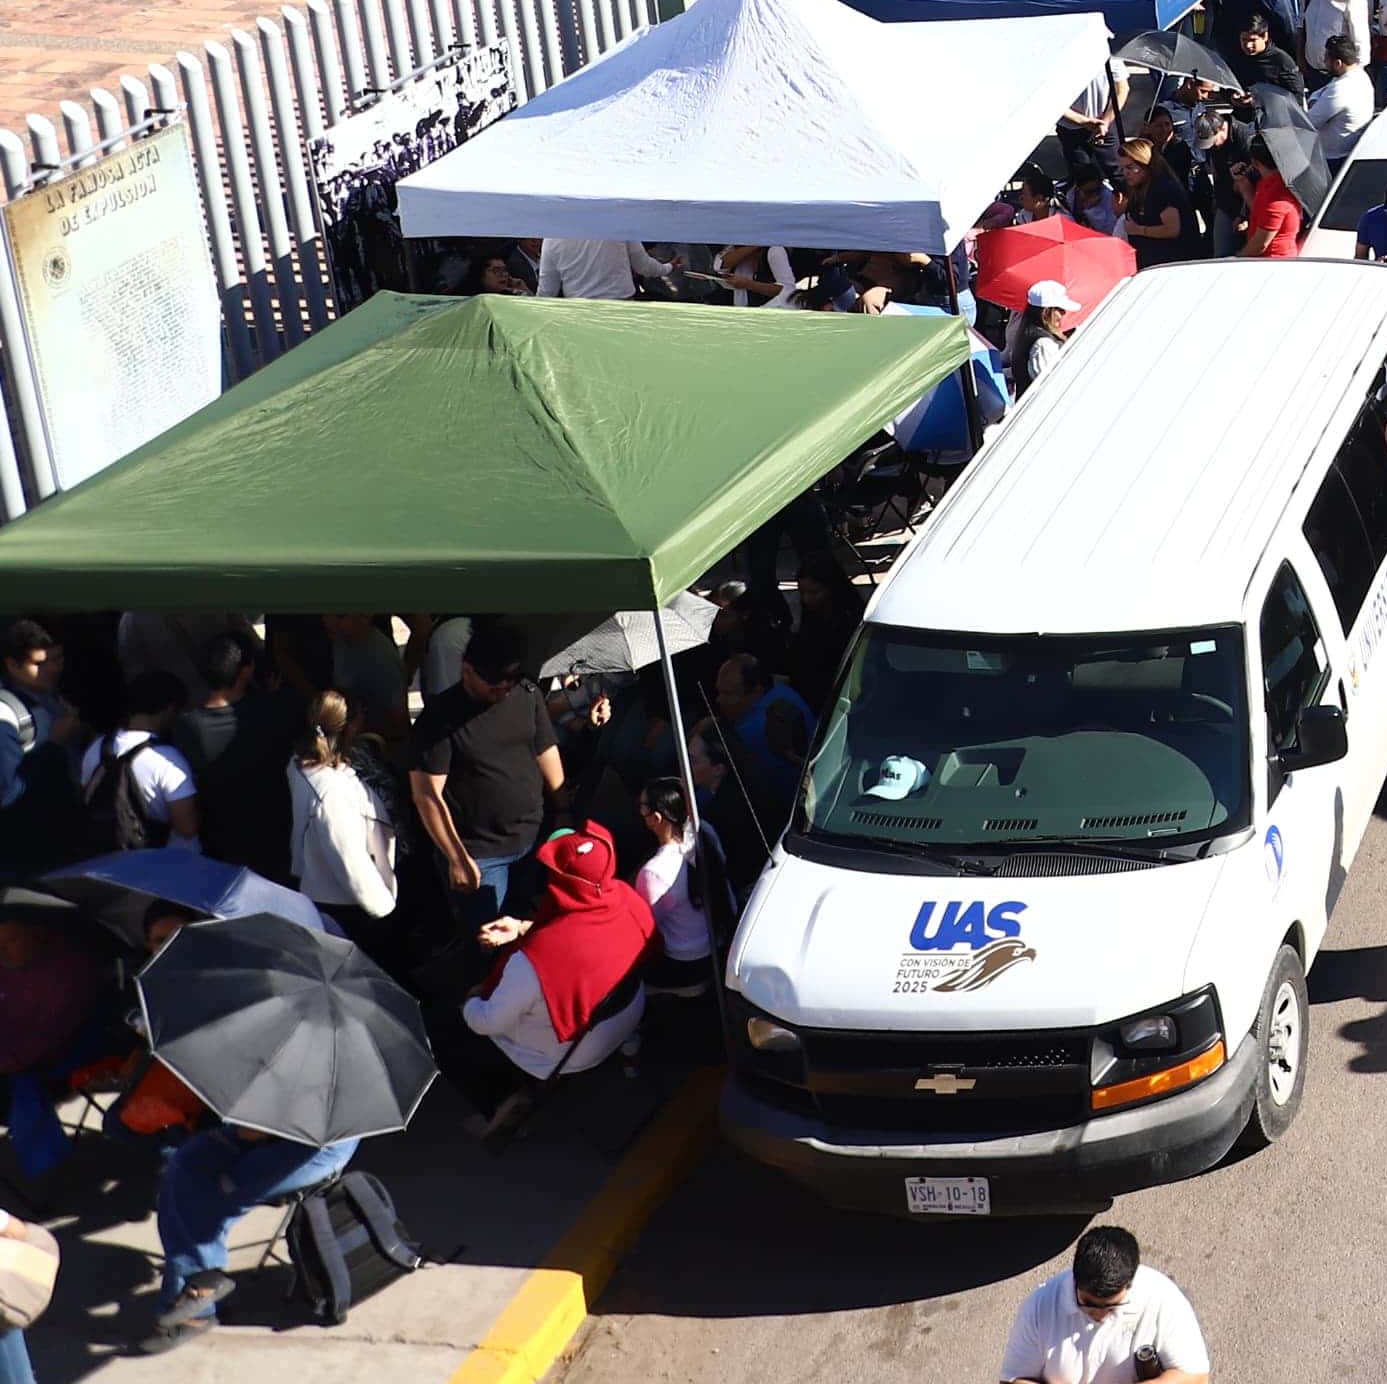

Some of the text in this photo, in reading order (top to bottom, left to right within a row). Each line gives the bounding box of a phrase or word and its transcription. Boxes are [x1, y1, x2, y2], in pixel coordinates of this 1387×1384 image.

[909, 901, 1028, 951] UAS
[900, 957, 971, 967] CON VISIÓN DE
[896, 969, 940, 979] FUTURO
[892, 981, 928, 993] 2025
[910, 1186, 986, 1202] VSH-10-18
